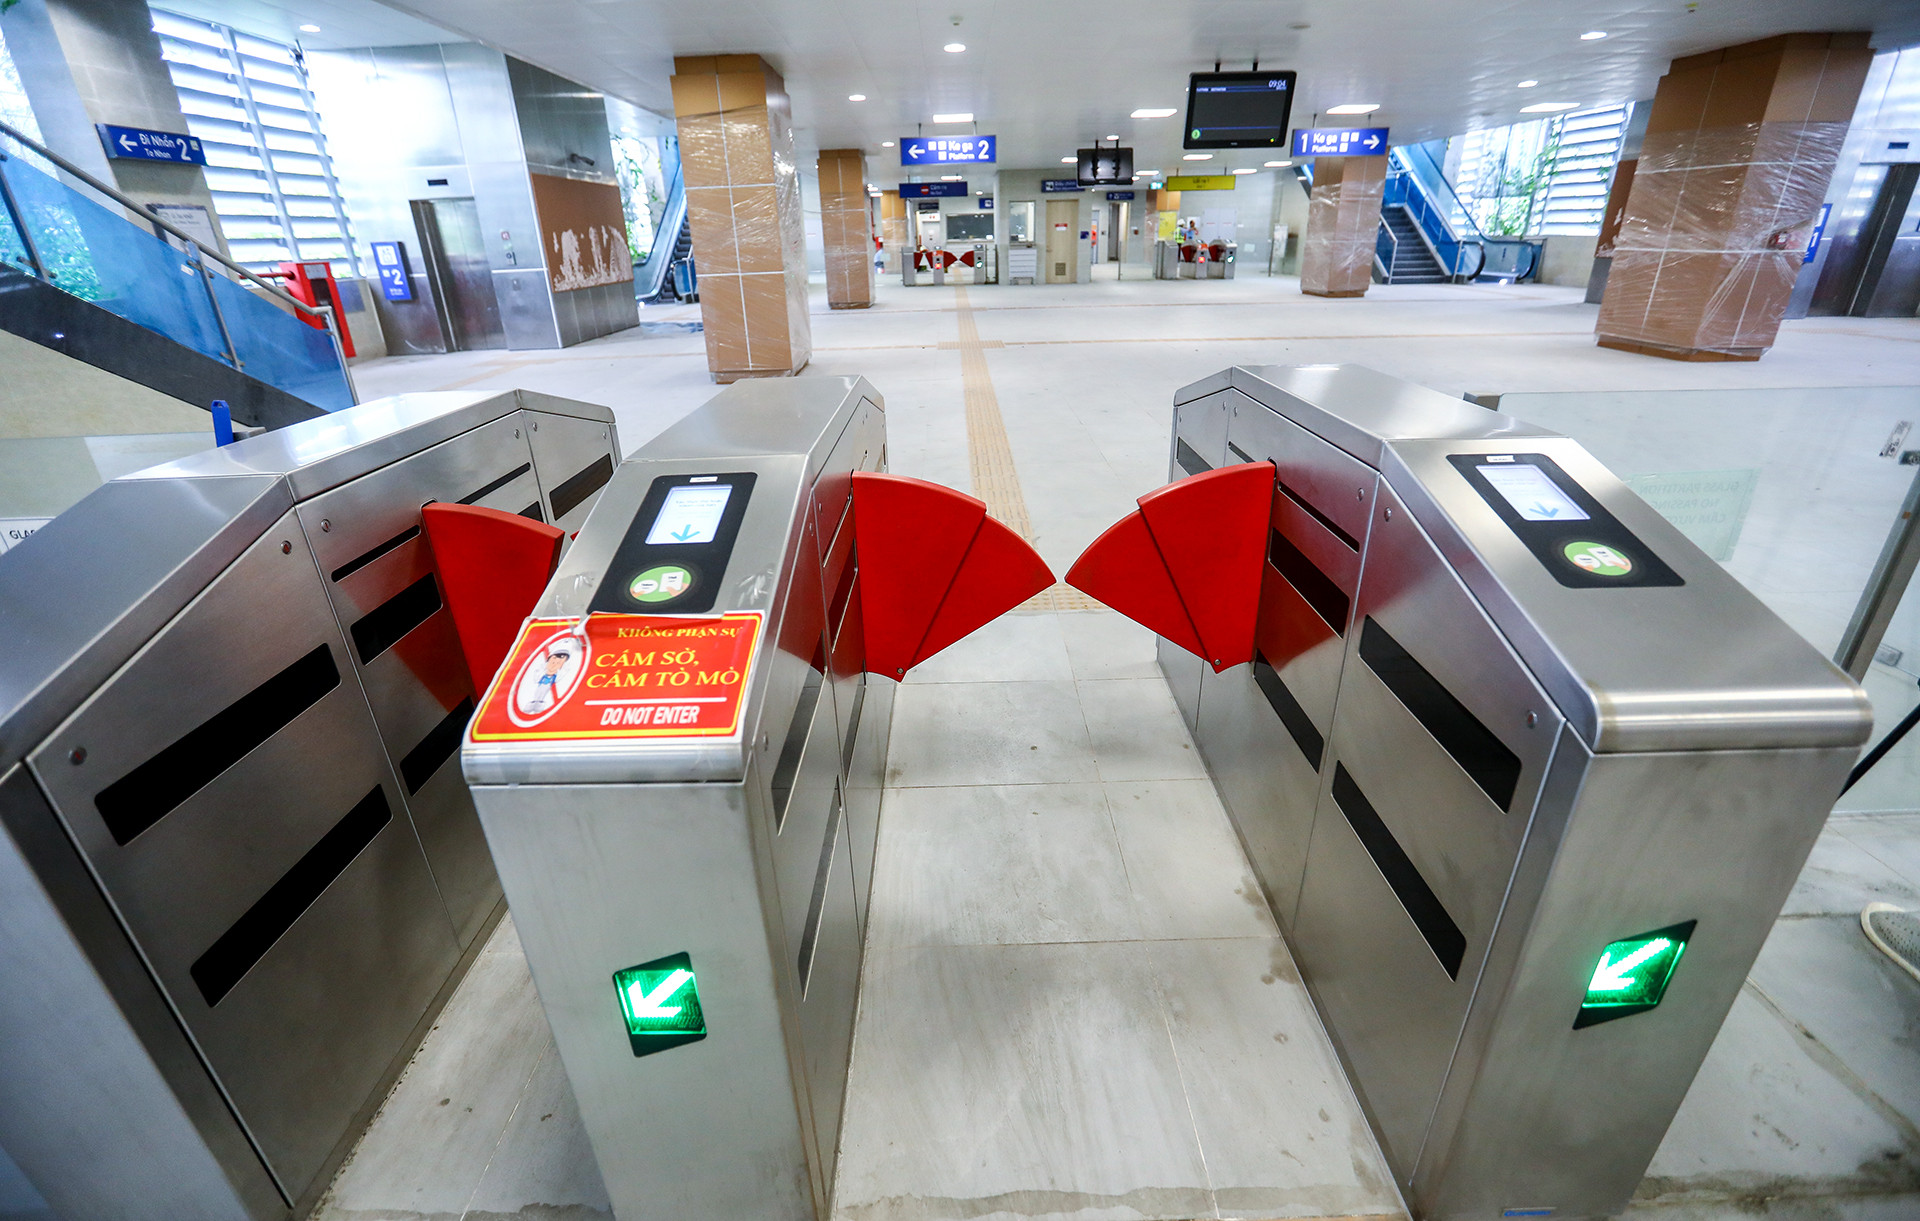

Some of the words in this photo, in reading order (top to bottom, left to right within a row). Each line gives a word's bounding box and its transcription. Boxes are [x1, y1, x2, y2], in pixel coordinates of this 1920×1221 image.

[176, 138, 192, 161] 2
[978, 139, 990, 160] 2
[1301, 133, 1309, 153] 1
[391, 268, 404, 285] 2
[617, 625, 674, 638] KHÔNG
[676, 627, 718, 638] PHẬN
[655, 667, 691, 687] TÒ
[695, 666, 740, 686] MÒ
[600, 707, 624, 726] DO
[622, 706, 655, 725] NOT
[652, 705, 701, 725] ENTER
